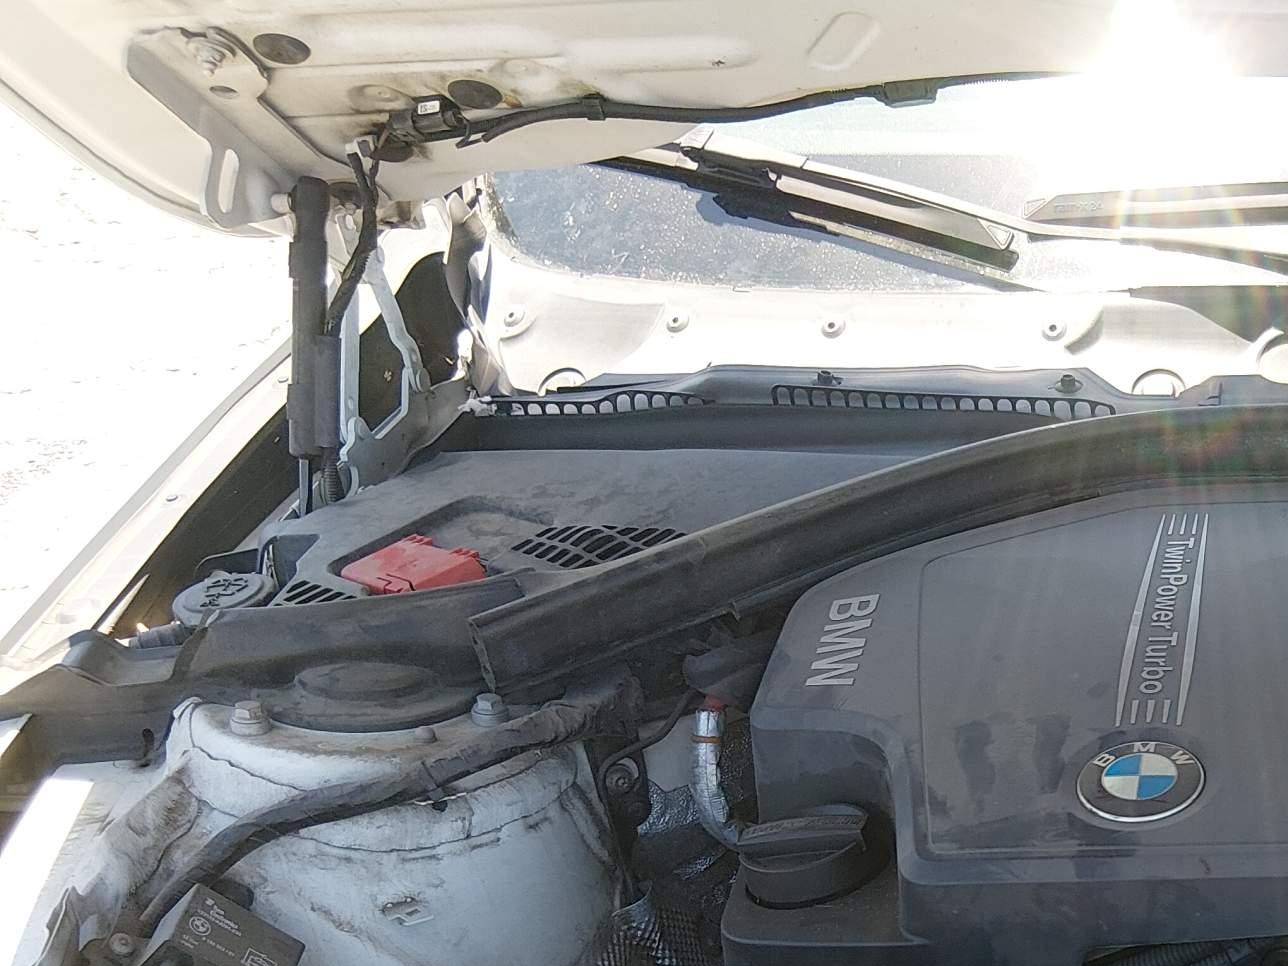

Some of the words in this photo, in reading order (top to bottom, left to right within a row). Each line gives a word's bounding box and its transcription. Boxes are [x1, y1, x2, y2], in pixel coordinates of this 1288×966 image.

[1150, 536, 1195, 629] TwinPower
[805, 593, 880, 687] BMW
[1138, 631, 1179, 694] Turbo
[1092, 741, 1196, 768] BMW
